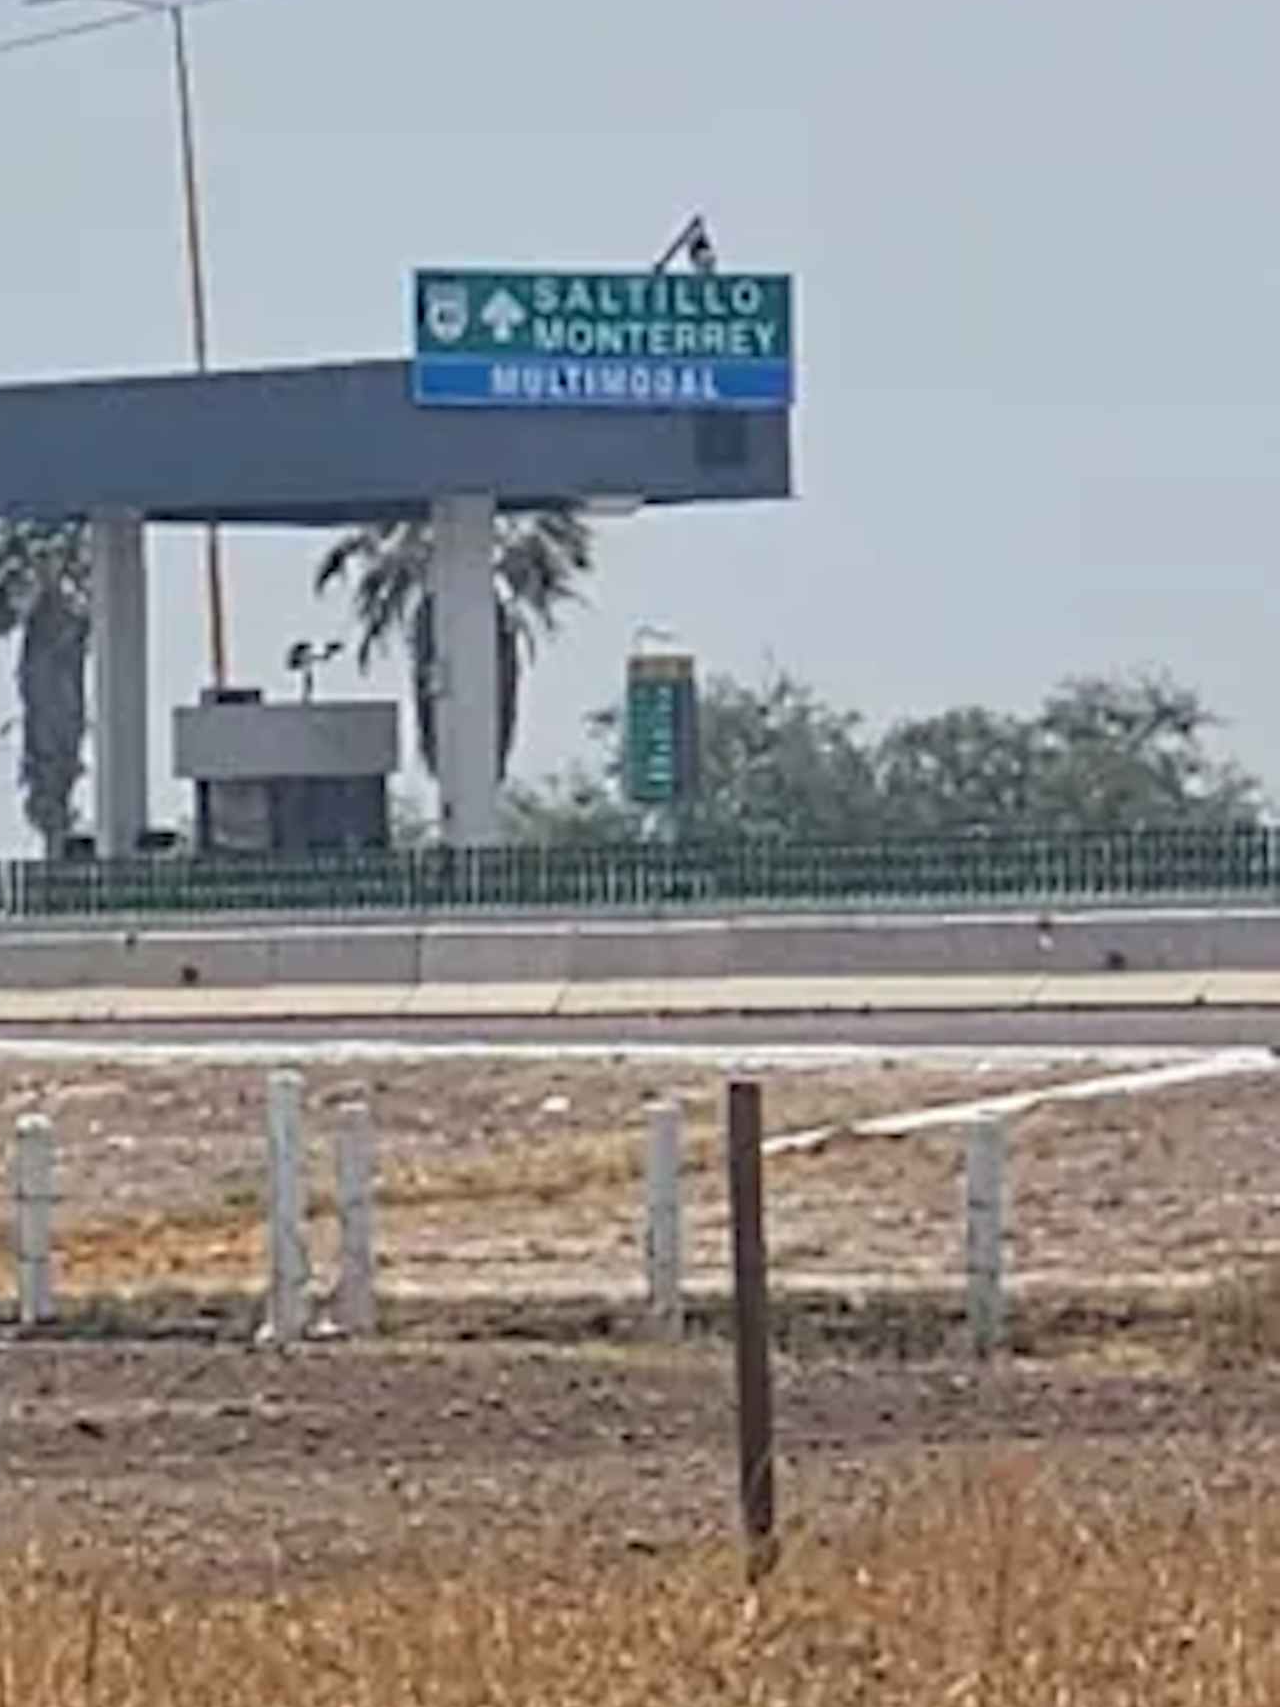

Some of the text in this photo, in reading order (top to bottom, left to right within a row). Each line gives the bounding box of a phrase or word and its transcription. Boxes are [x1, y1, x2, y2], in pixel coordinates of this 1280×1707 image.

[532, 277, 763, 314] SALTILLO
[532, 316, 777, 355] MONTERREY
[492, 365, 719, 398] MULTIMODAL
